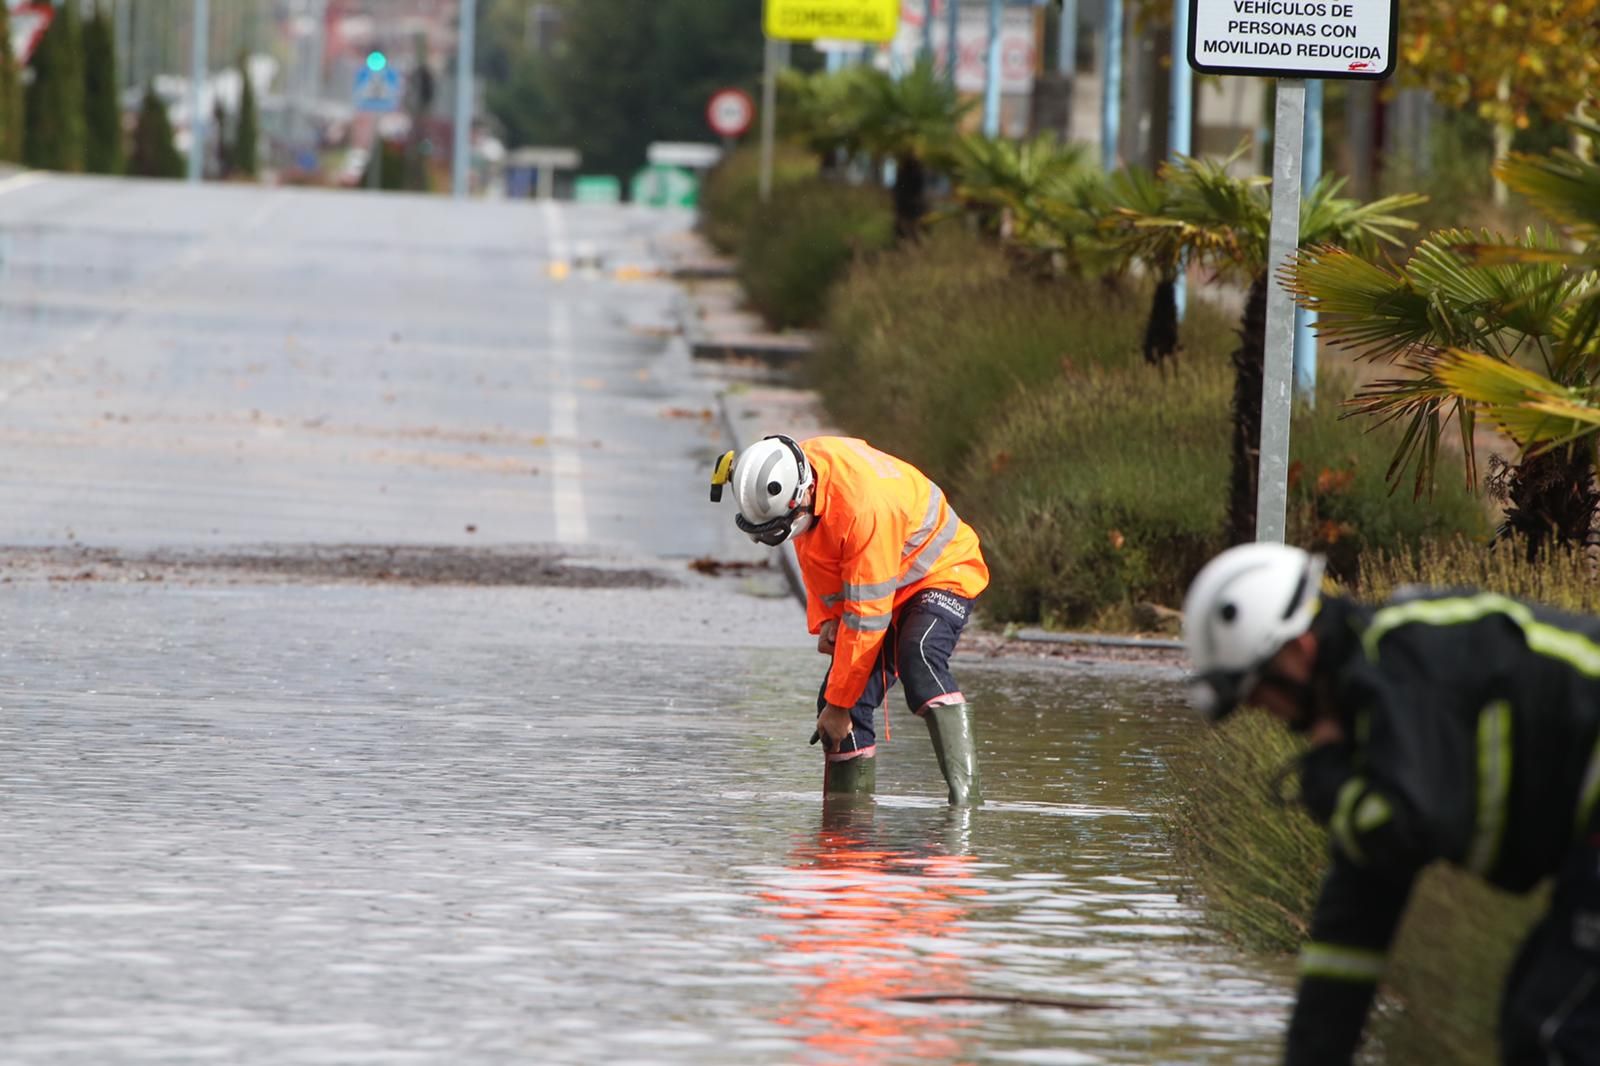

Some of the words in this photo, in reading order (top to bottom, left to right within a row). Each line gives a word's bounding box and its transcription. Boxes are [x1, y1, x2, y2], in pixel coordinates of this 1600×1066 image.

[1331, 4, 1353, 18] DE
[1228, 20, 1316, 37] PERSONAS
[1321, 24, 1357, 38] CON
[1203, 40, 1292, 56] MOVILIDAD
[1297, 43, 1381, 60] REDUCIDA
